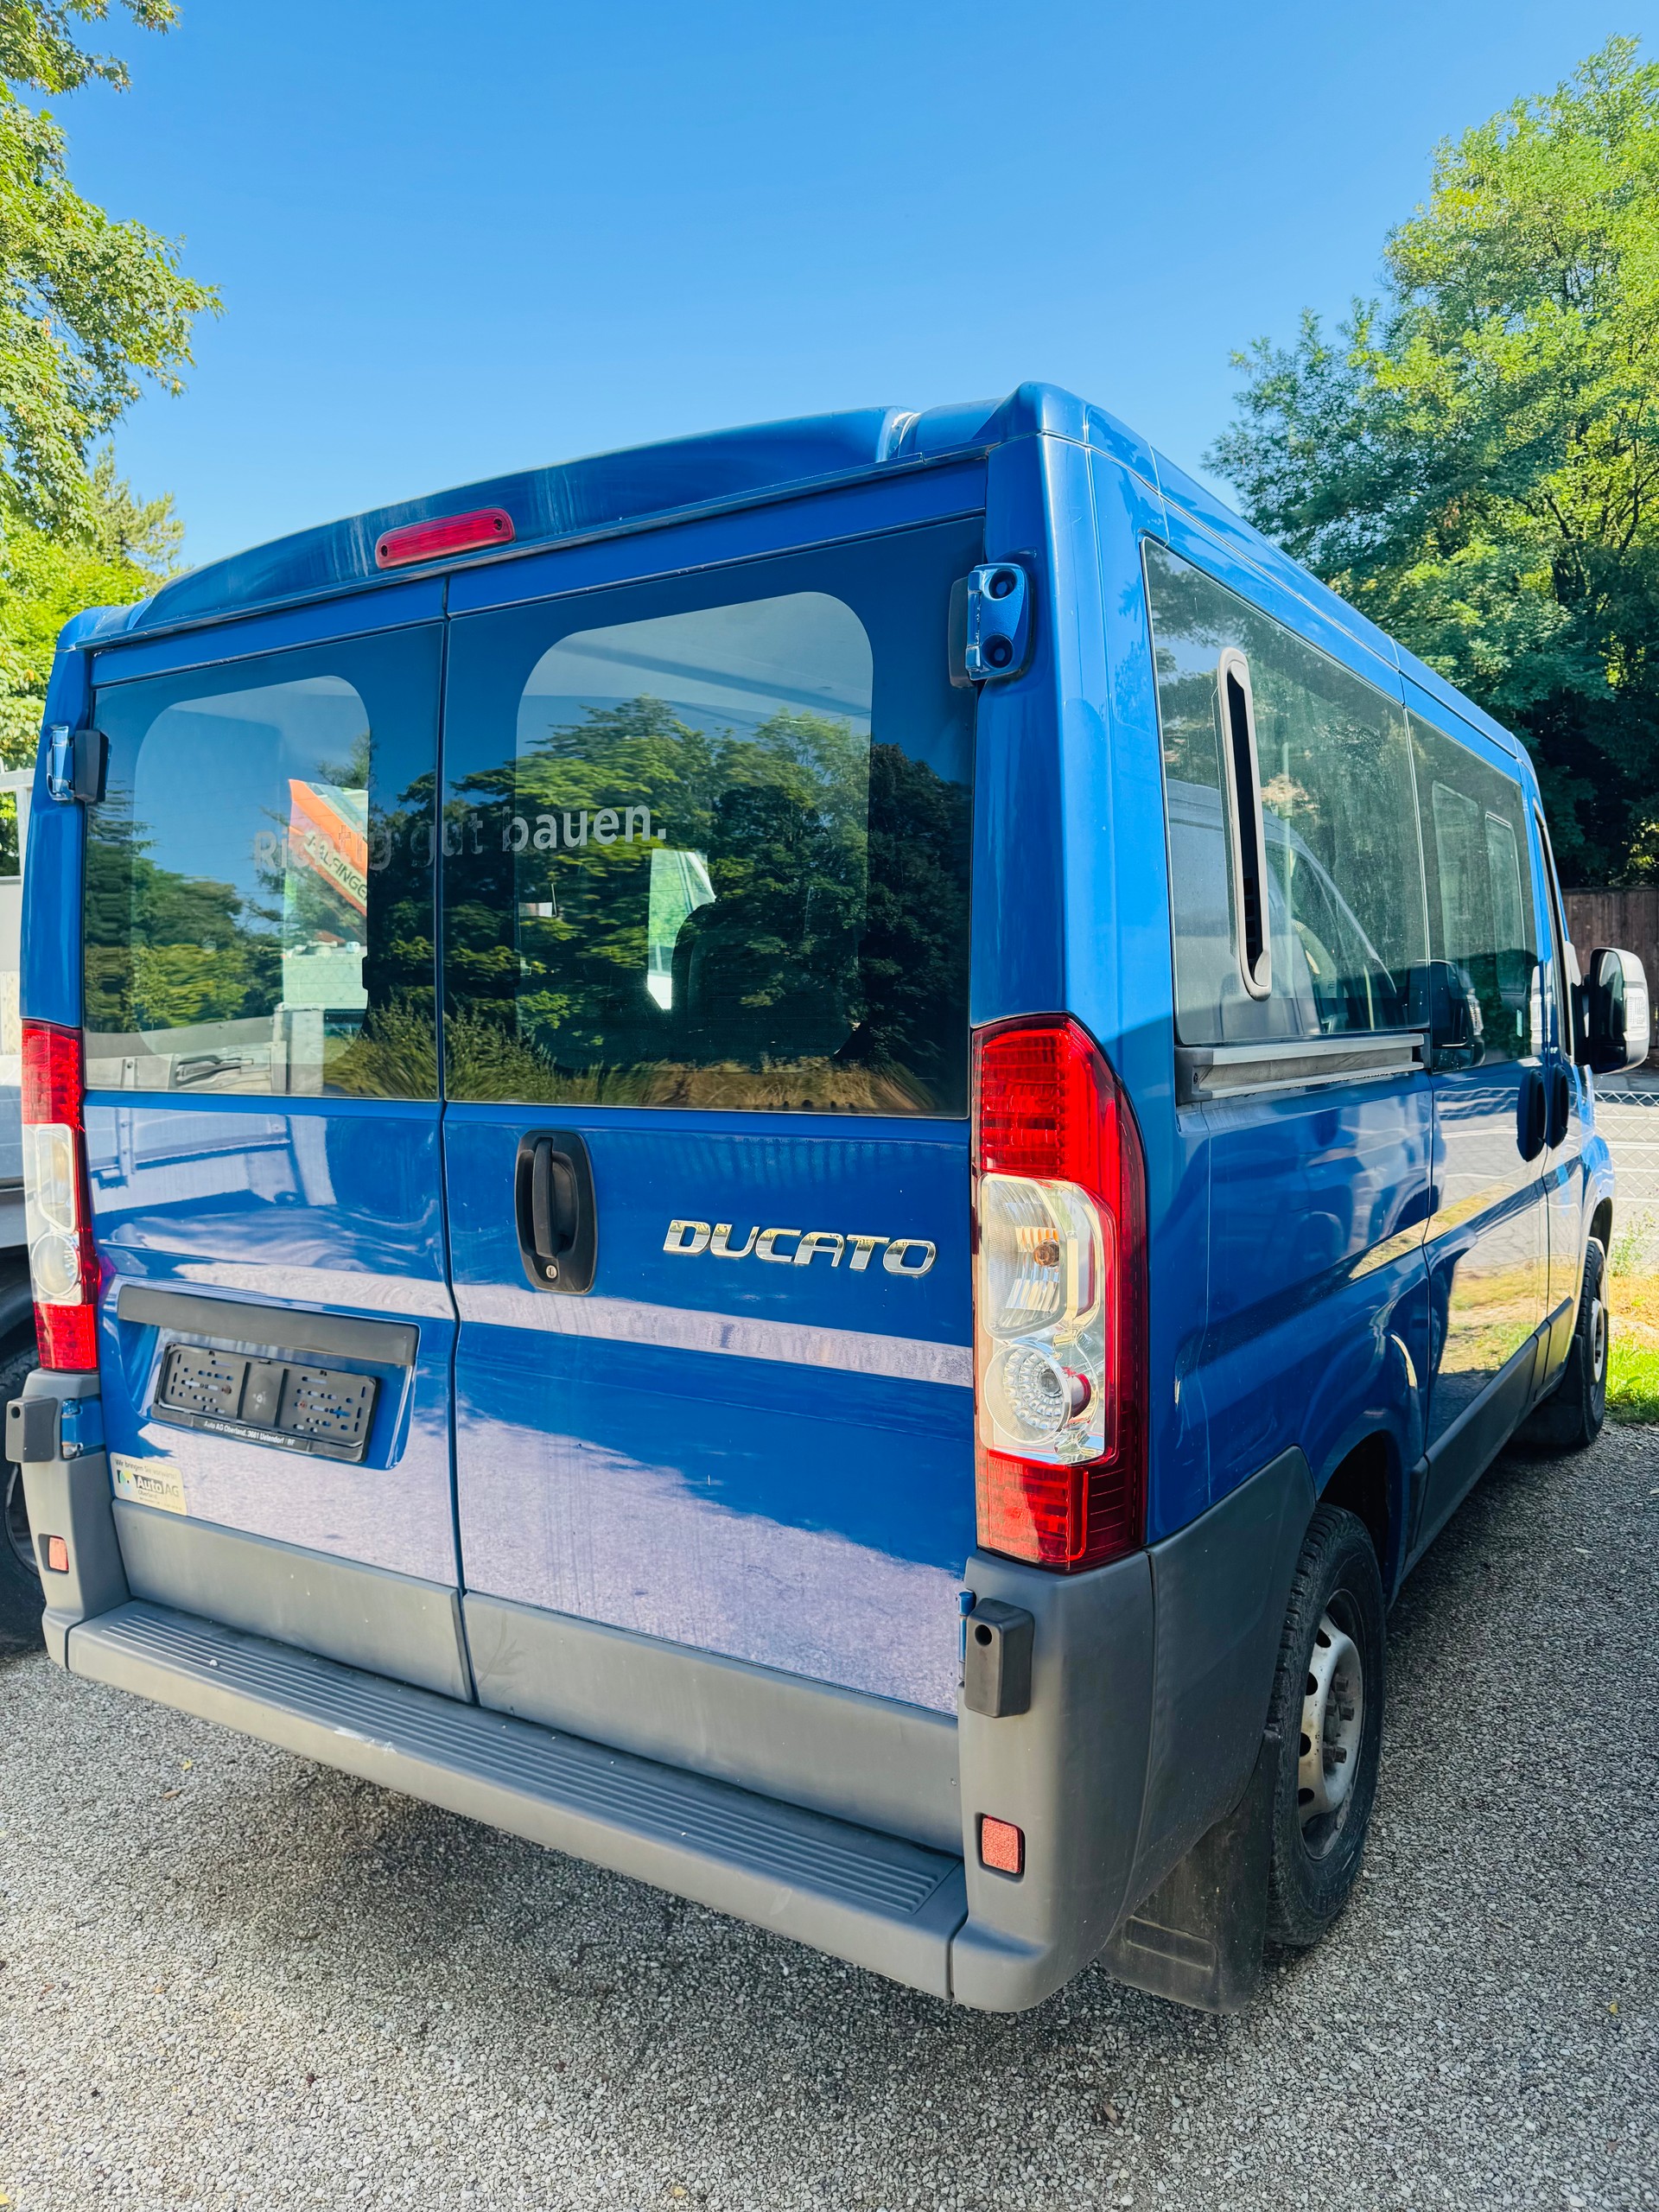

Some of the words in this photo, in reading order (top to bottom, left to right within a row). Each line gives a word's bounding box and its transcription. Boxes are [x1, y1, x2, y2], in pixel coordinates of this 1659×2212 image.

[410, 812, 483, 868] gut
[502, 804, 666, 853] bauen.
[663, 1219, 938, 1275] DUCATO
[204, 1421, 216, 1429] Auto
[137, 1476, 162, 1493] Auto
[164, 1484, 180, 1497] AG
